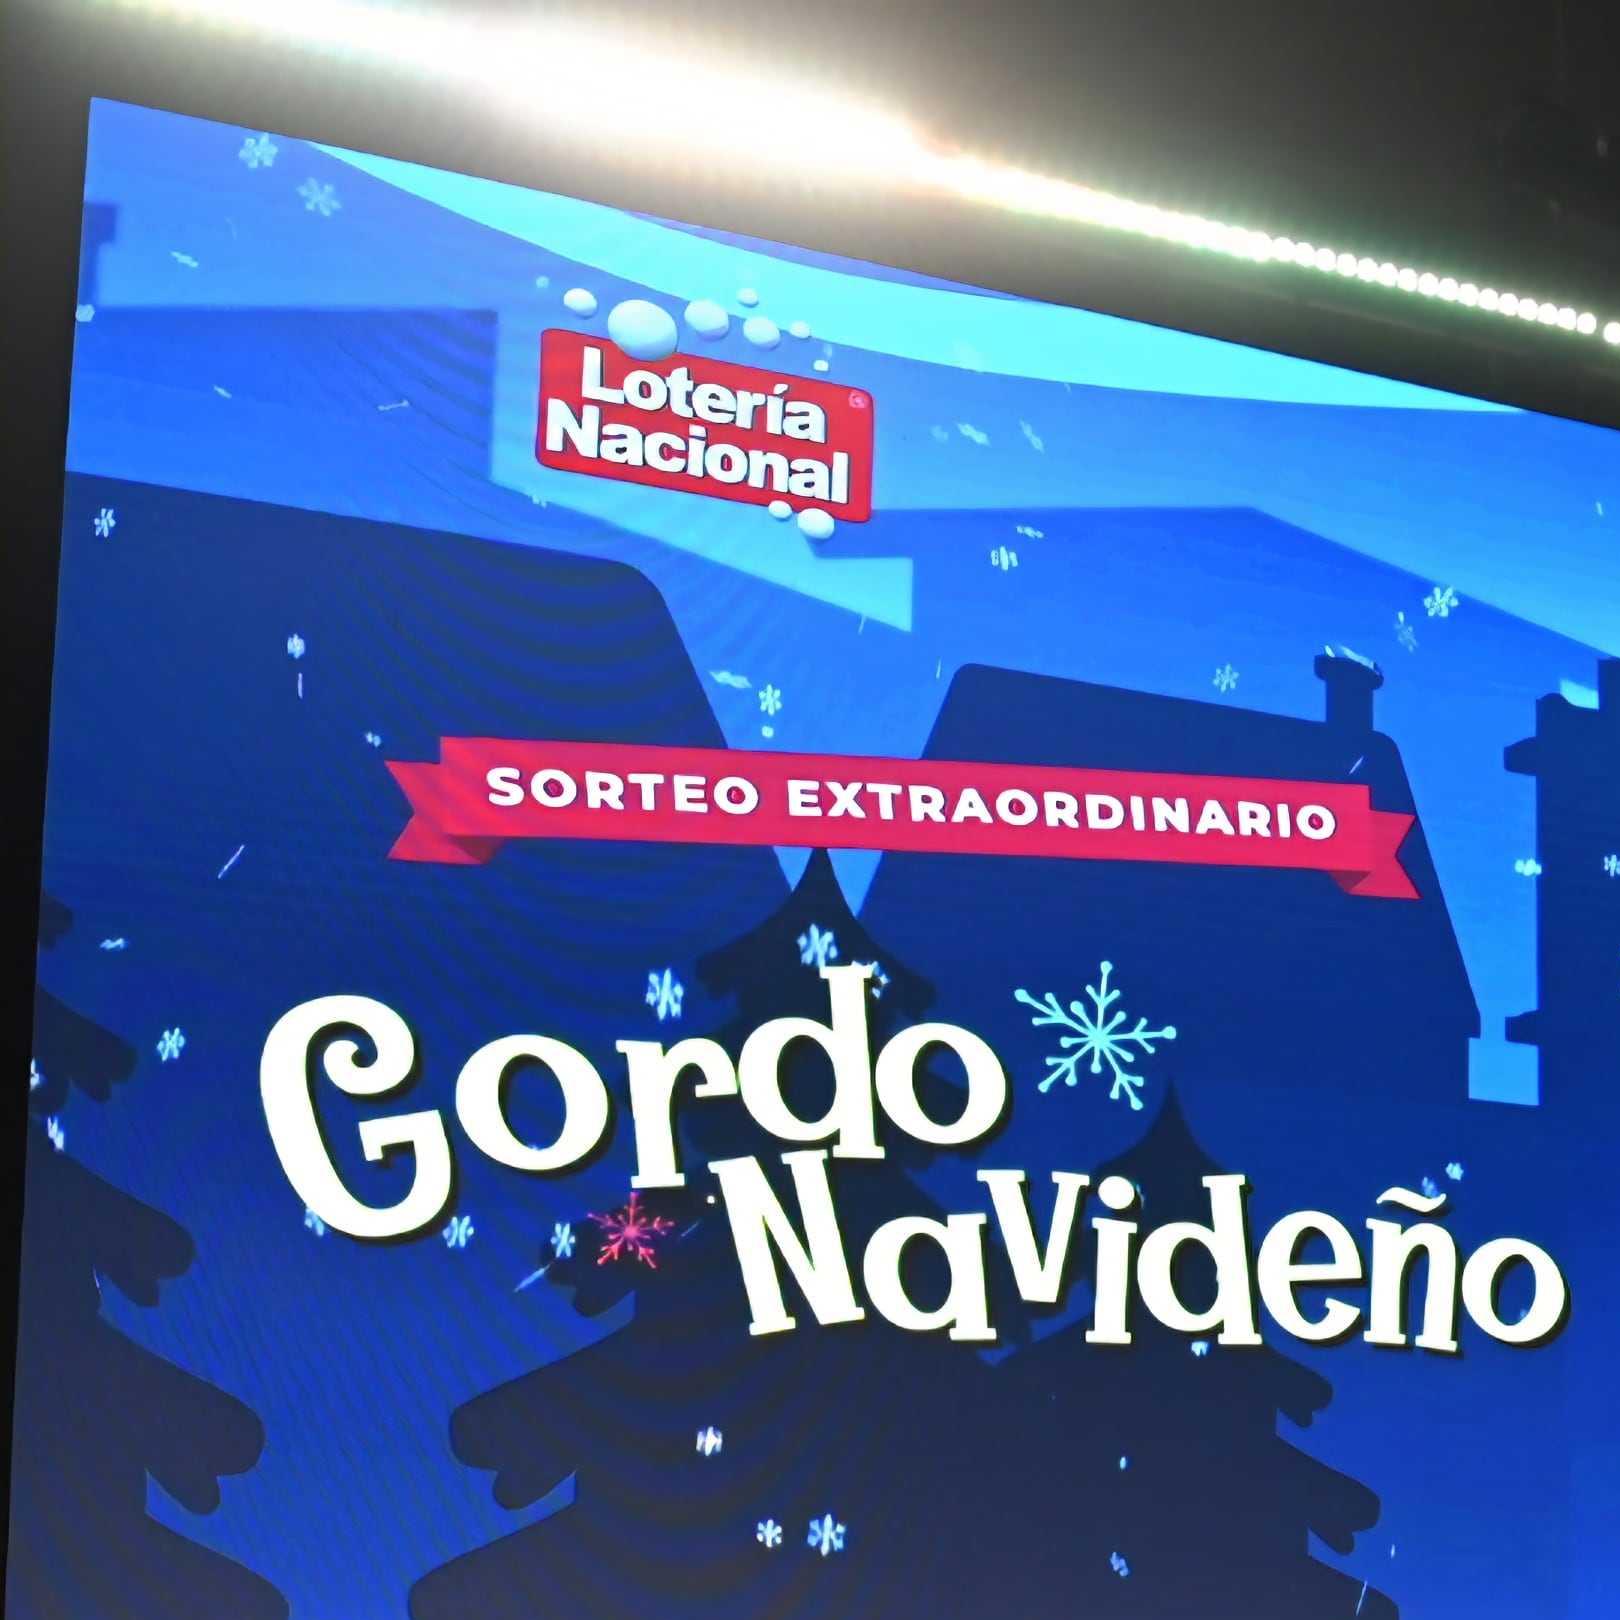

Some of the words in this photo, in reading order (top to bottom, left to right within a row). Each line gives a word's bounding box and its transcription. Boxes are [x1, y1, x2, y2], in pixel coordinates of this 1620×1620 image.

[581, 346, 826, 444] Lotería
[546, 398, 849, 504] Nacional
[486, 767, 759, 815] SORTEO
[787, 779, 1337, 841] EXTRAORDINARIO
[260, 962, 1007, 1238] Gordo
